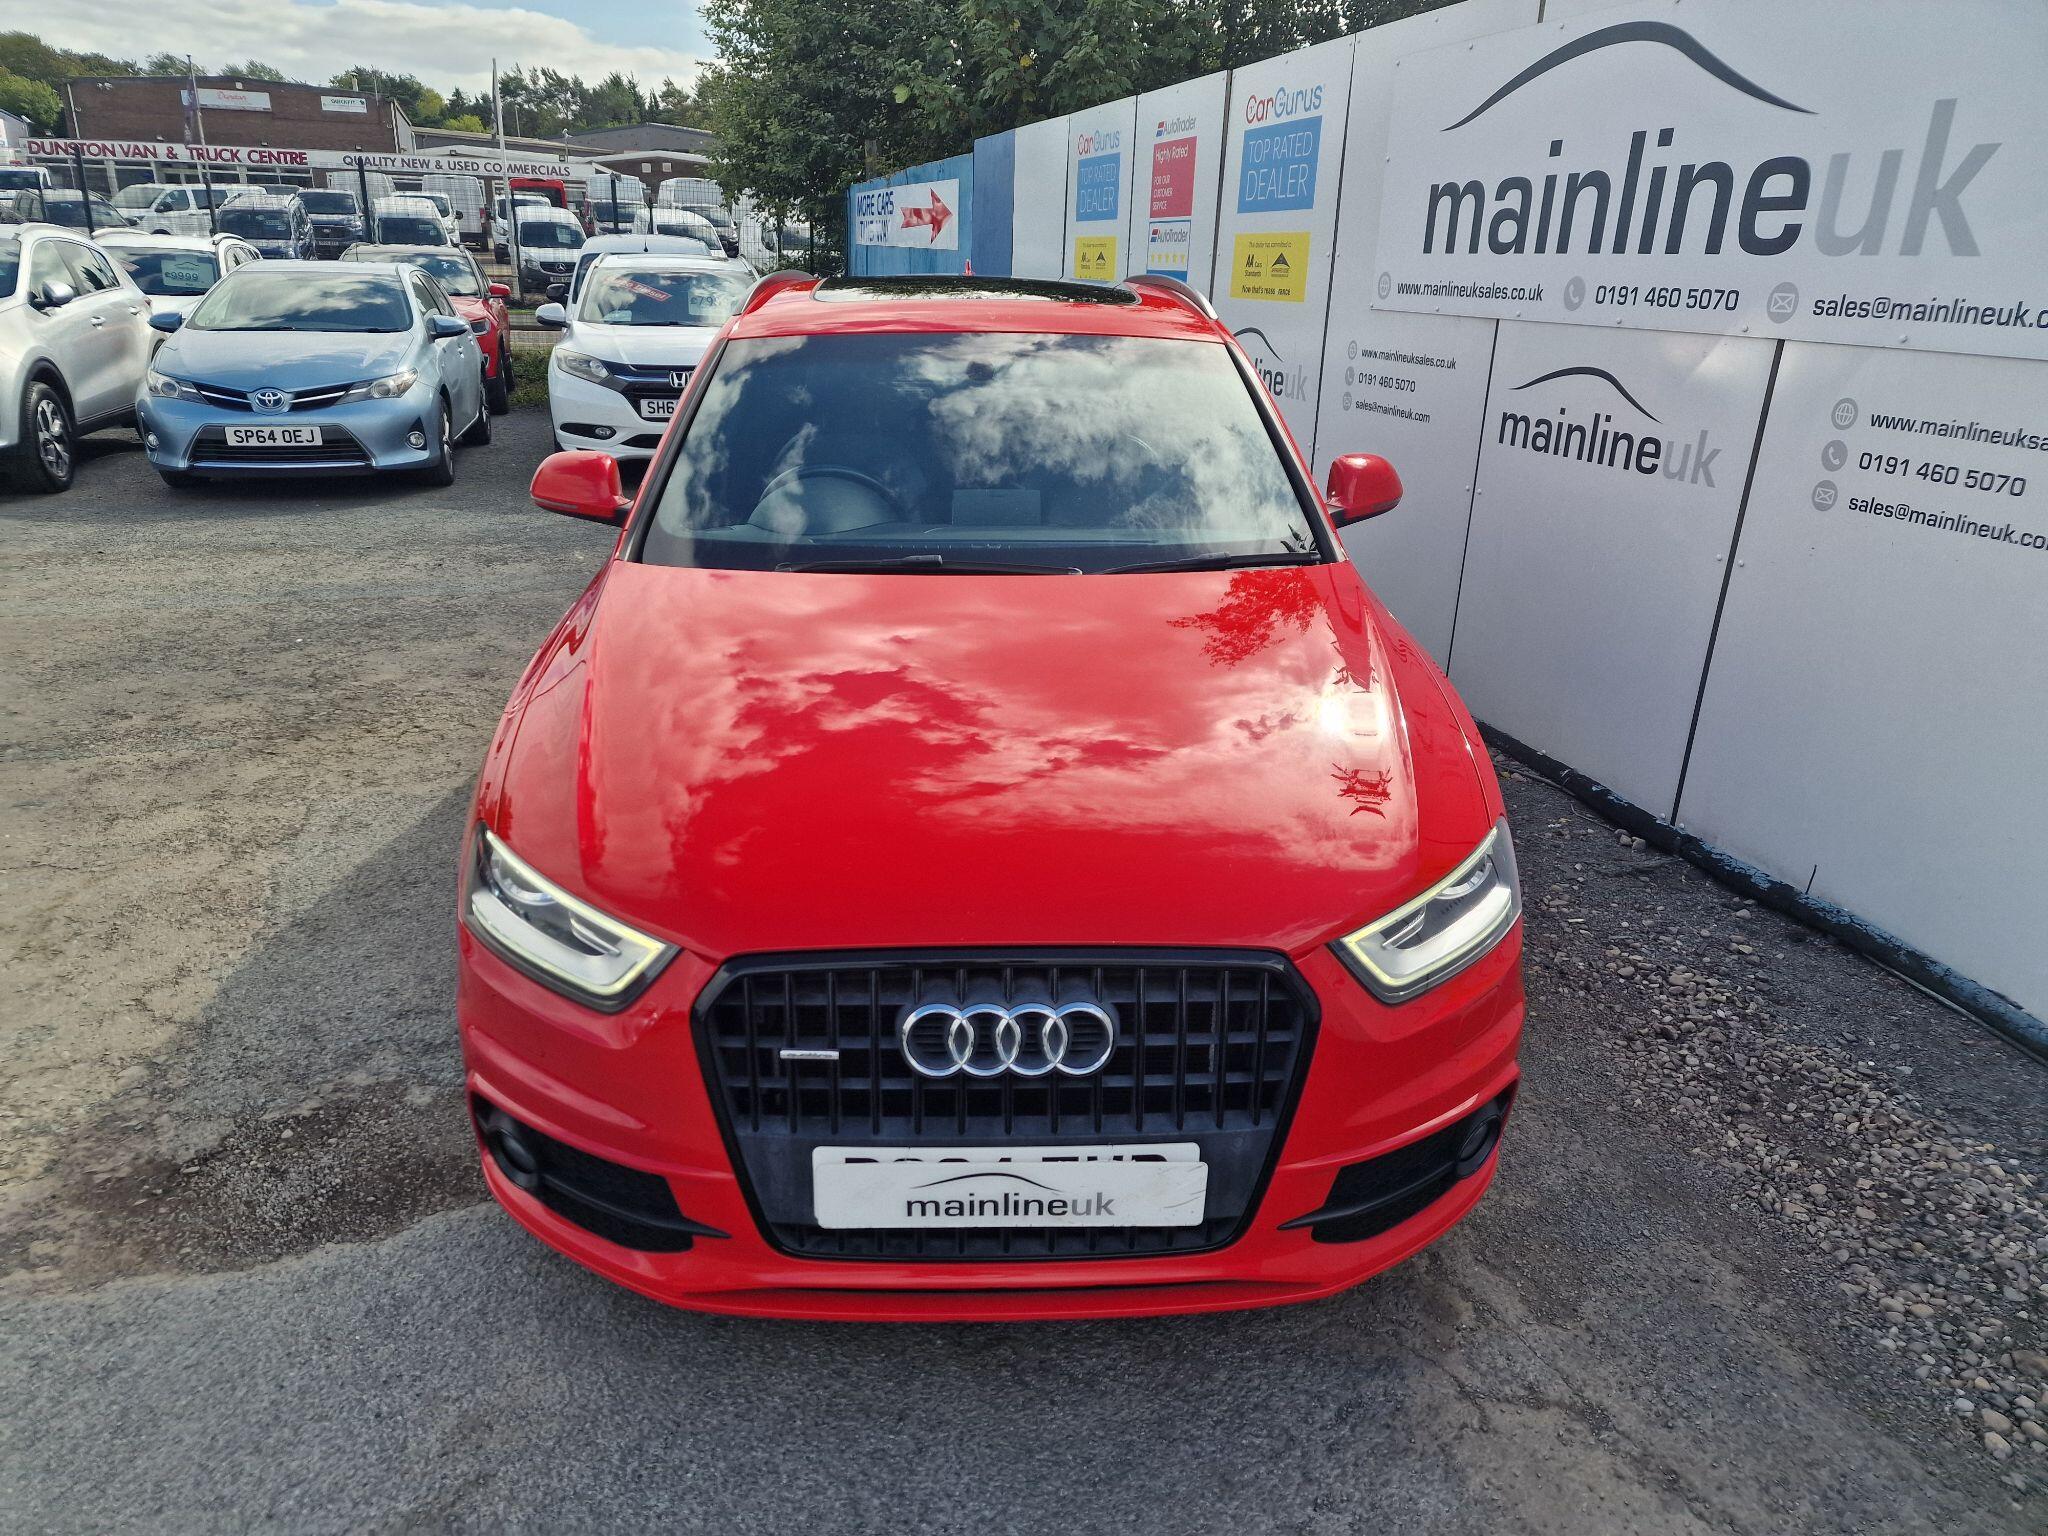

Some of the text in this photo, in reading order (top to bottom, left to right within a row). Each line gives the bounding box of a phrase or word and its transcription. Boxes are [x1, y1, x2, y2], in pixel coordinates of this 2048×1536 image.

[1246, 85, 1323, 124] CarGurus
[27, 141, 308, 166] DUNSTON VAN & TRUCK CENTRE
[1078, 130, 1120, 155] CarGurus
[1249, 131, 1313, 164] TOP RATED
[342, 155, 571, 177] QUALITY NEW & USED COMMERCIALS
[1423, 97, 2003, 257] mainlineuk
[1246, 164, 1309, 201] DEALER
[857, 190, 895, 217] MORE CARS
[1080, 187, 1115, 213] DEALER
[1398, 280, 1543, 302] www.mainlineuksales.co.uk
[1595, 285, 1740, 311] 0191 460 5070
[1361, 348, 1457, 370] www.mainlineuksales.co.uk
[1358, 372, 1416, 393] 0191 460 5070
[1355, 398, 1431, 424] sales@mainlineuk.com
[233, 429, 315, 444] SP64 OEJ
[1498, 407, 1722, 489] mainlineuk
[1858, 452, 2027, 497] 0191 460 5070
[1848, 496, 2048, 551] sales@mainlineuk.co
[906, 1192, 1116, 1217] mainlineuk
